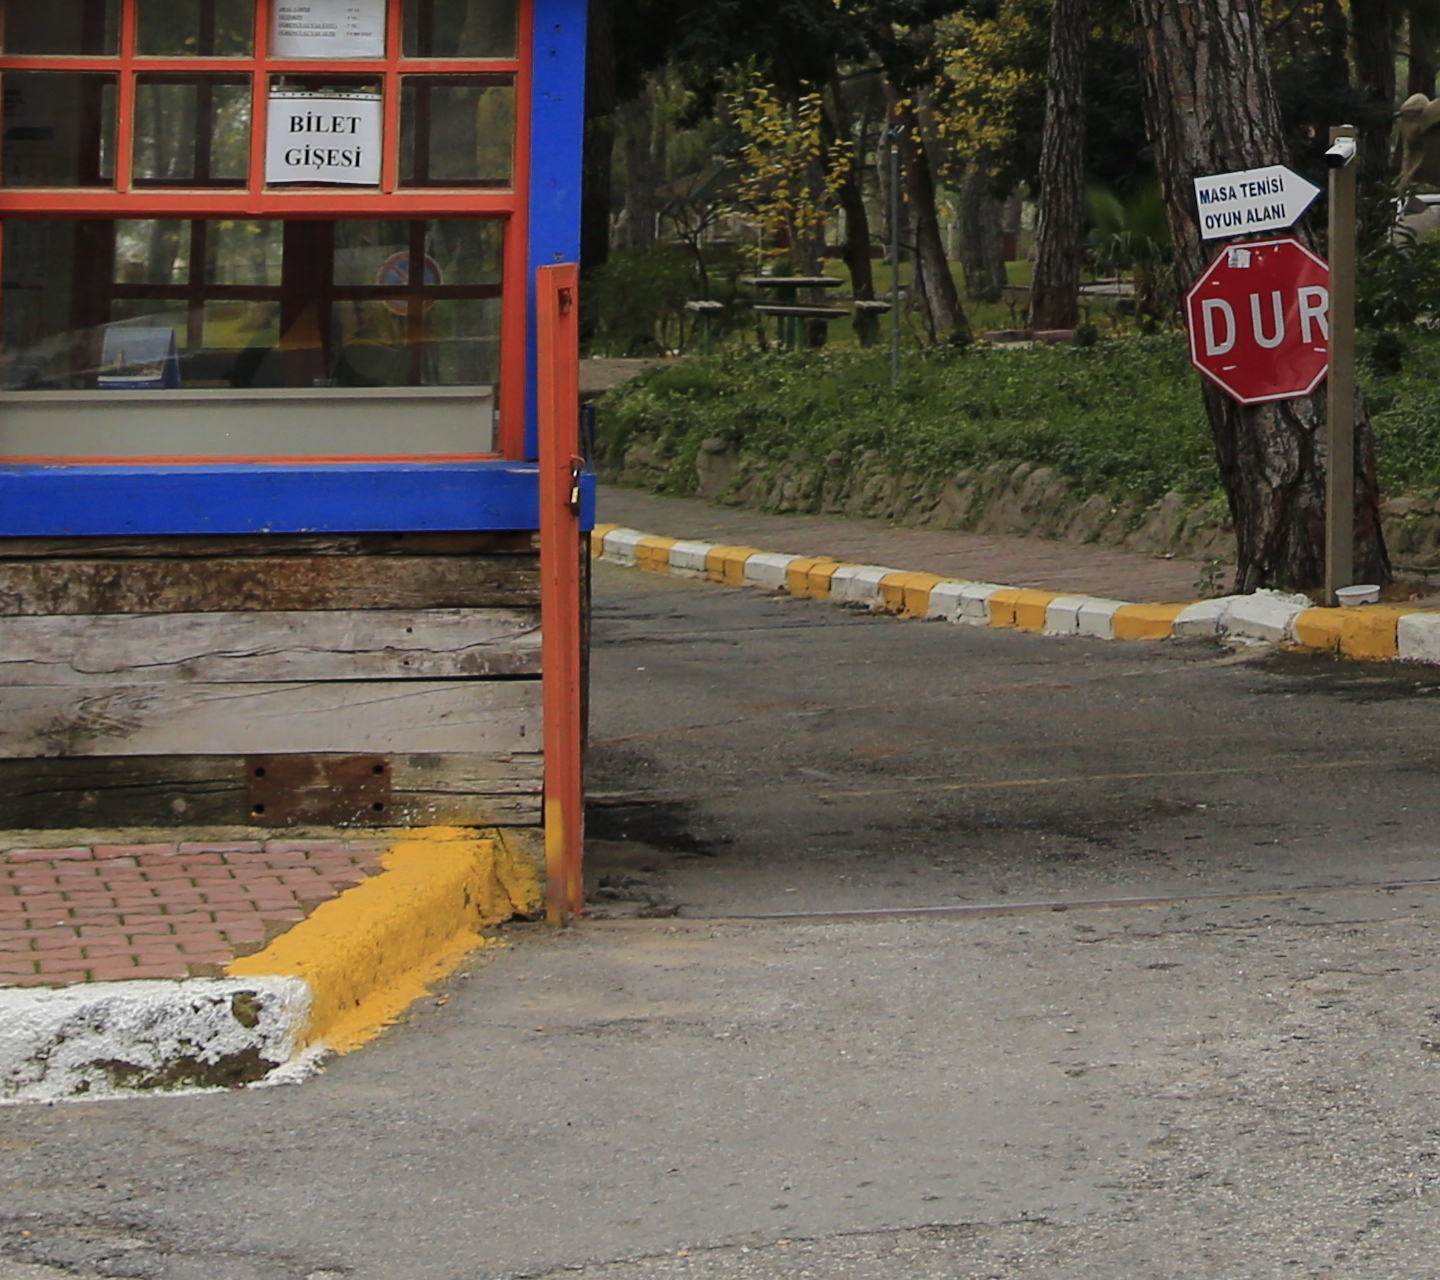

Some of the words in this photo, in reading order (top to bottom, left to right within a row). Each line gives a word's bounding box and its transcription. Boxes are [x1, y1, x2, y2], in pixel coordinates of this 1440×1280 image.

[289, 111, 362, 134] BİLET
[284, 144, 362, 170] GİŞESİ
[1199, 185, 1238, 205] MASA
[1239, 174, 1285, 198] TENİSİ
[1205, 210, 1242, 230] OYUN
[1246, 203, 1286, 224] ALANI
[1201, 285, 1330, 356] DUR
